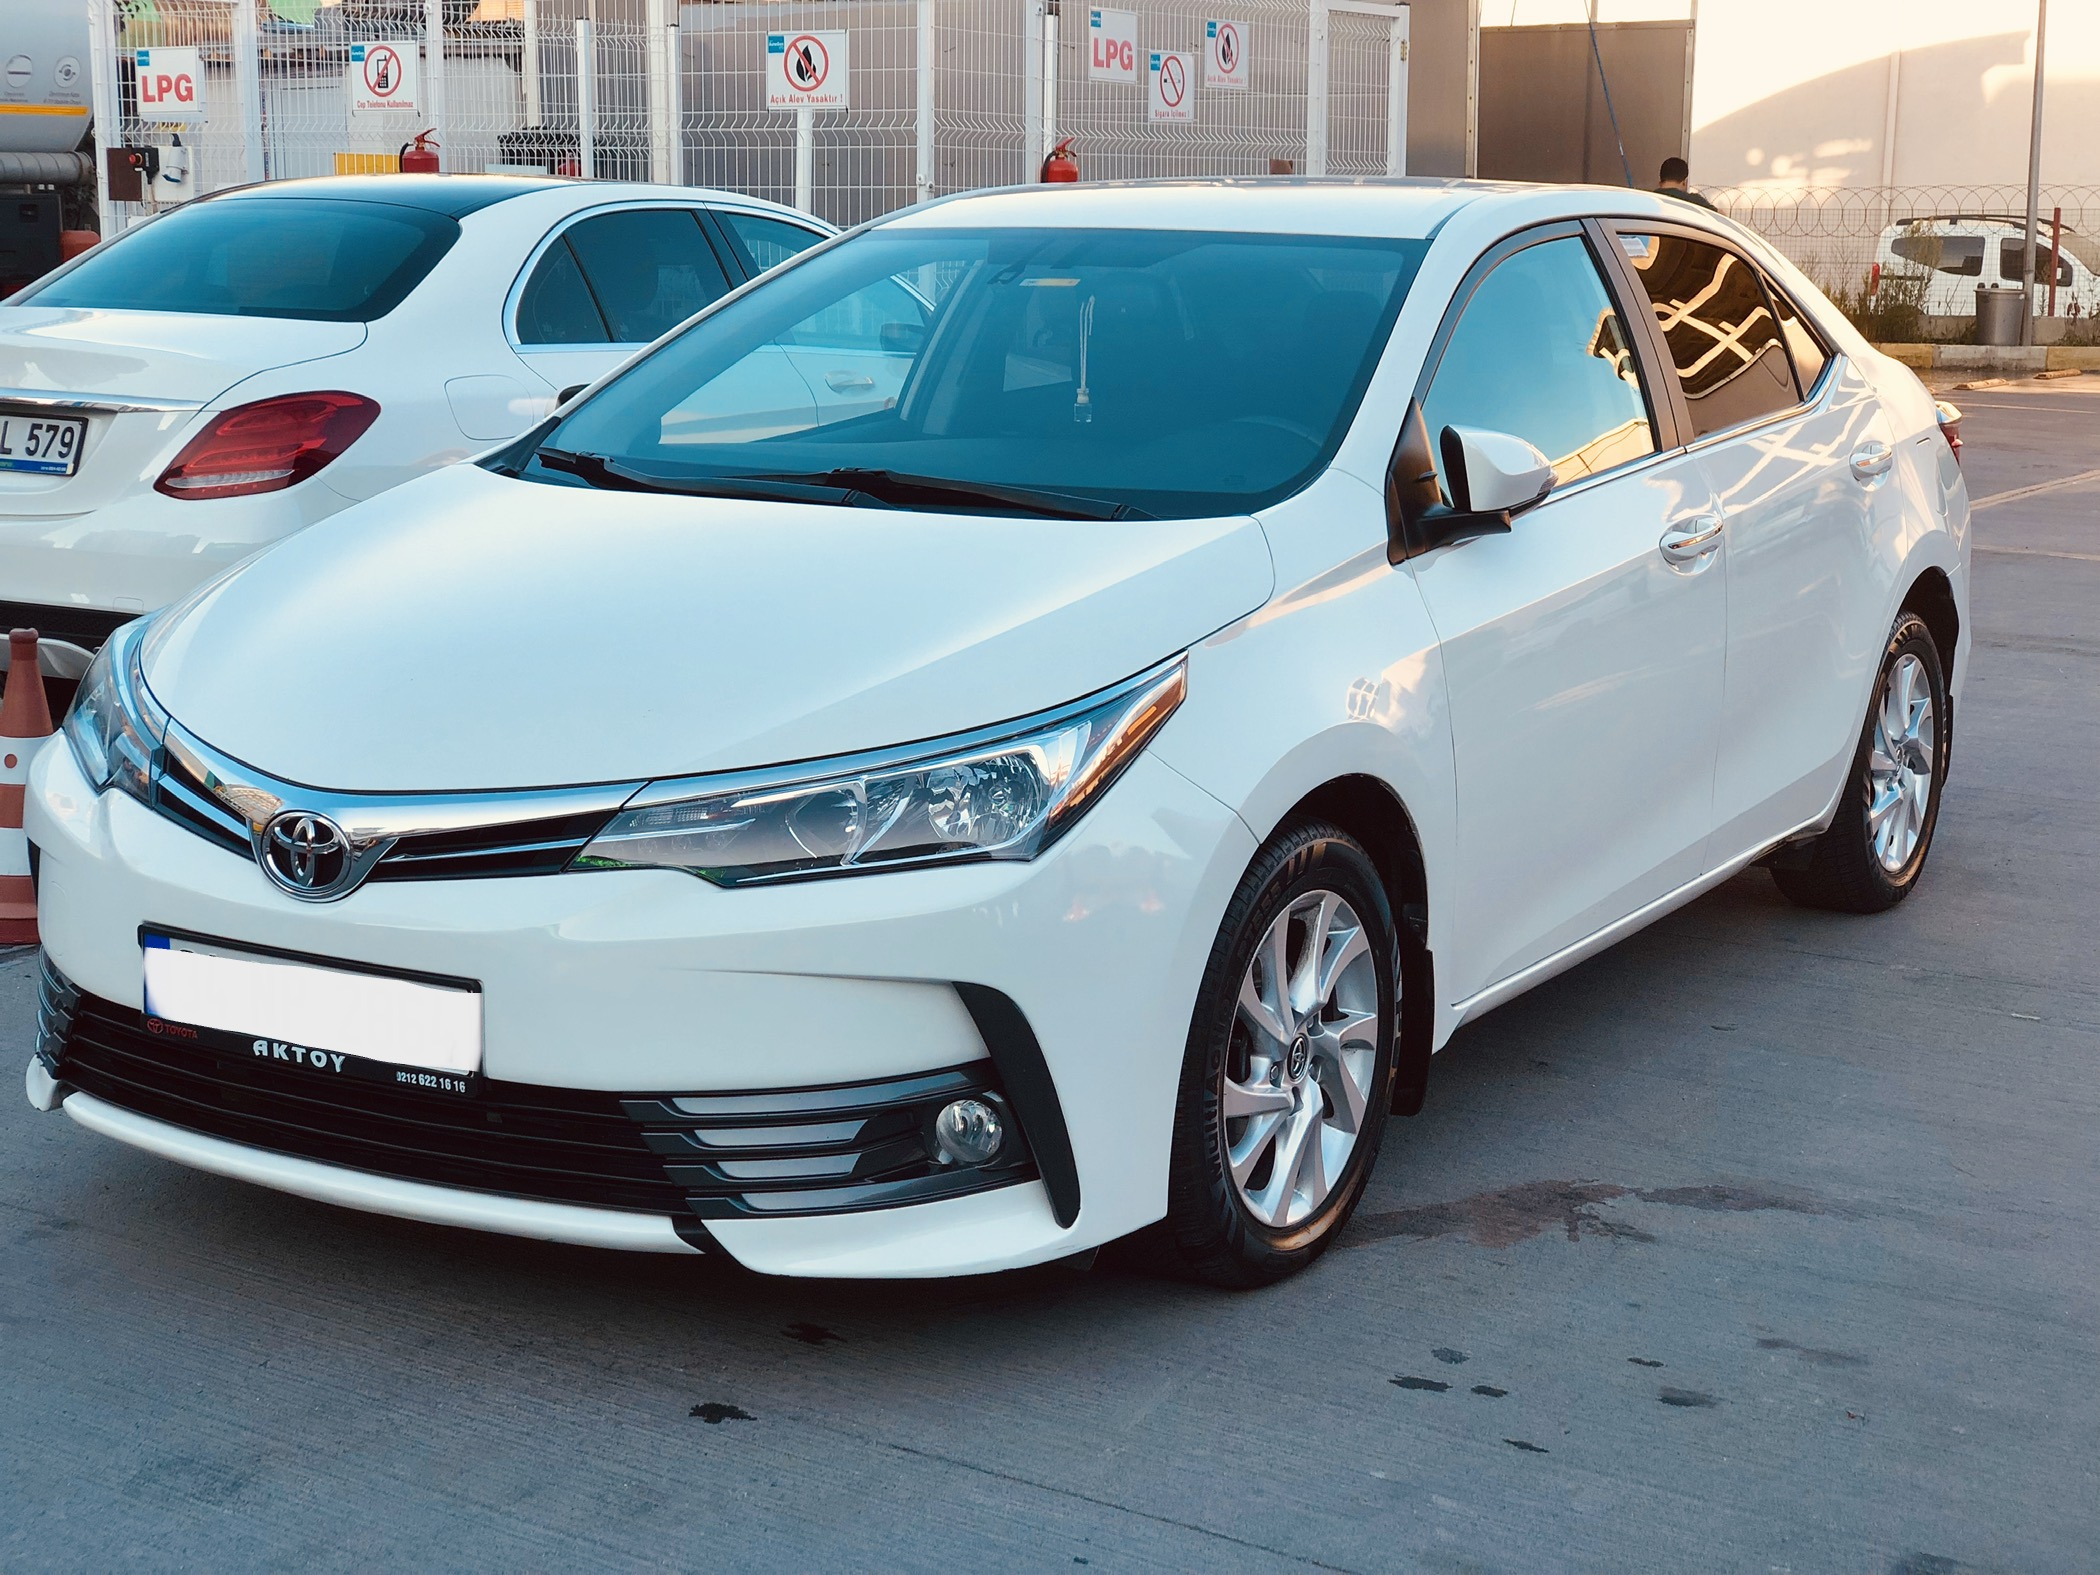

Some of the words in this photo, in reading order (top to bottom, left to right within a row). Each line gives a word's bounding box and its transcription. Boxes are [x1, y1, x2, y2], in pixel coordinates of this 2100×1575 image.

[1093, 37, 1134, 71] LPG
[141, 73, 194, 103] LPG
[356, 100, 366, 109] Cep
[770, 94, 786, 105] Açık
[788, 94, 804, 103] Alev
[806, 94, 838, 103] Yasaktır
[1155, 109, 1170, 119] Sigara
[25, 423, 75, 458] 579
[165, 1024, 198, 1039] TOYOTA
[253, 1040, 345, 1073] AKTOY
[396, 1071, 417, 1085] 0212
[418, 1073, 437, 1088] 622
[439, 1077, 452, 1090] 16
[453, 1080, 466, 1093] 16
